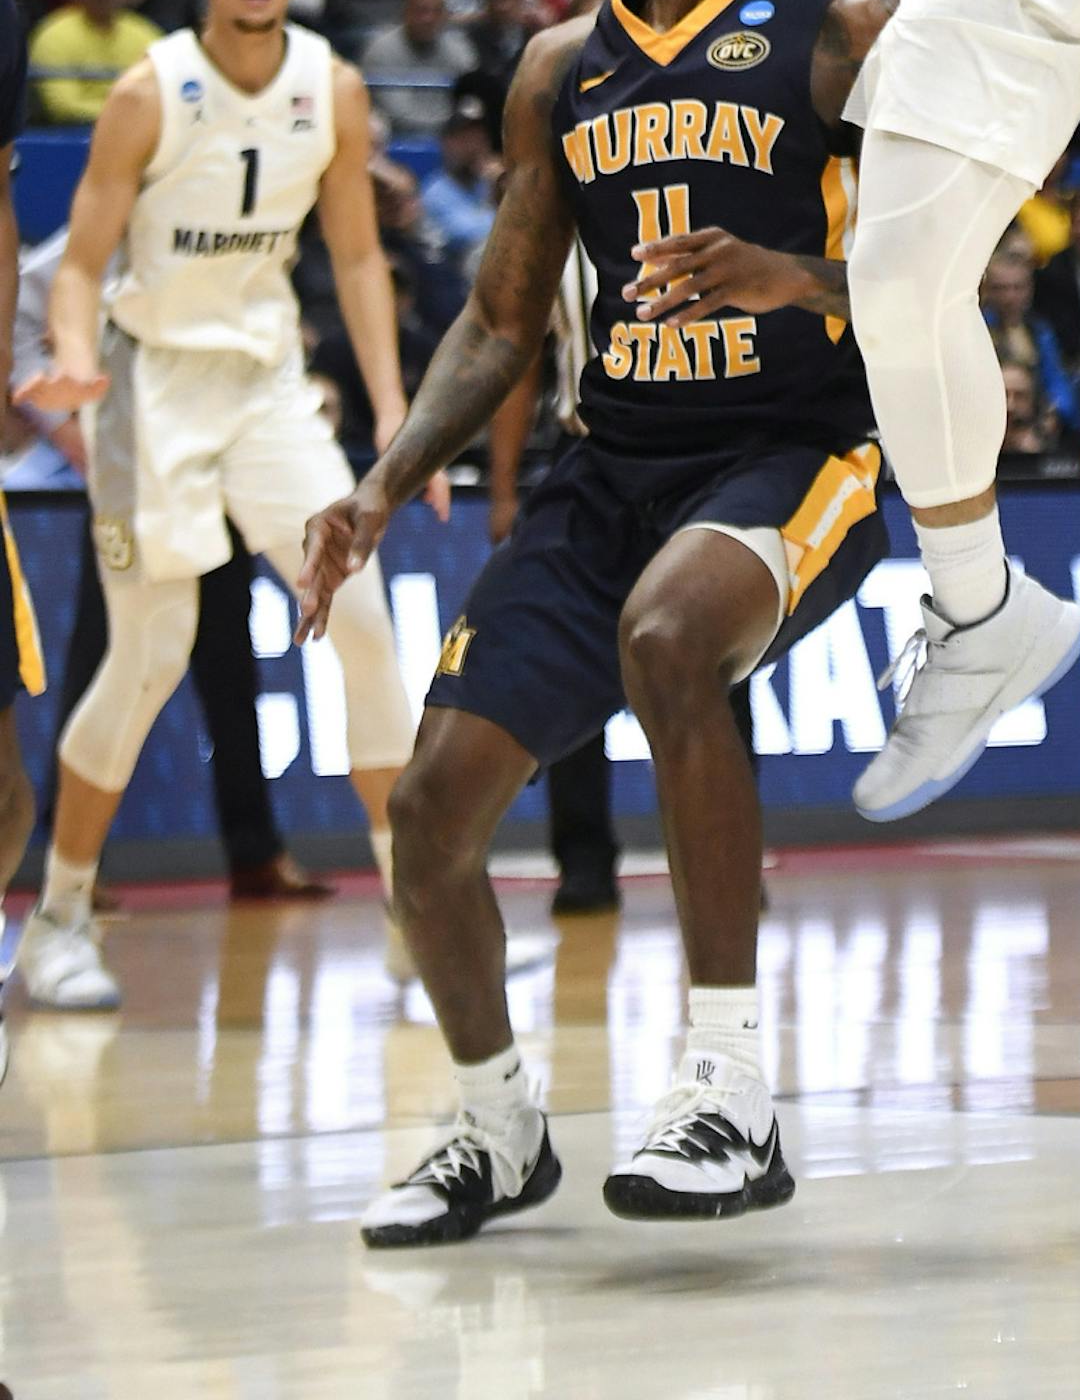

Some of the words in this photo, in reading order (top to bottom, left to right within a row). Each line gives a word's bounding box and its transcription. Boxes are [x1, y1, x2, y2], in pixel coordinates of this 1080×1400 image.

[719, 43, 757, 59] OVC
[562, 99, 785, 184] MURRAY
[240, 148, 258, 218] 1
[602, 316, 760, 381] STATE
